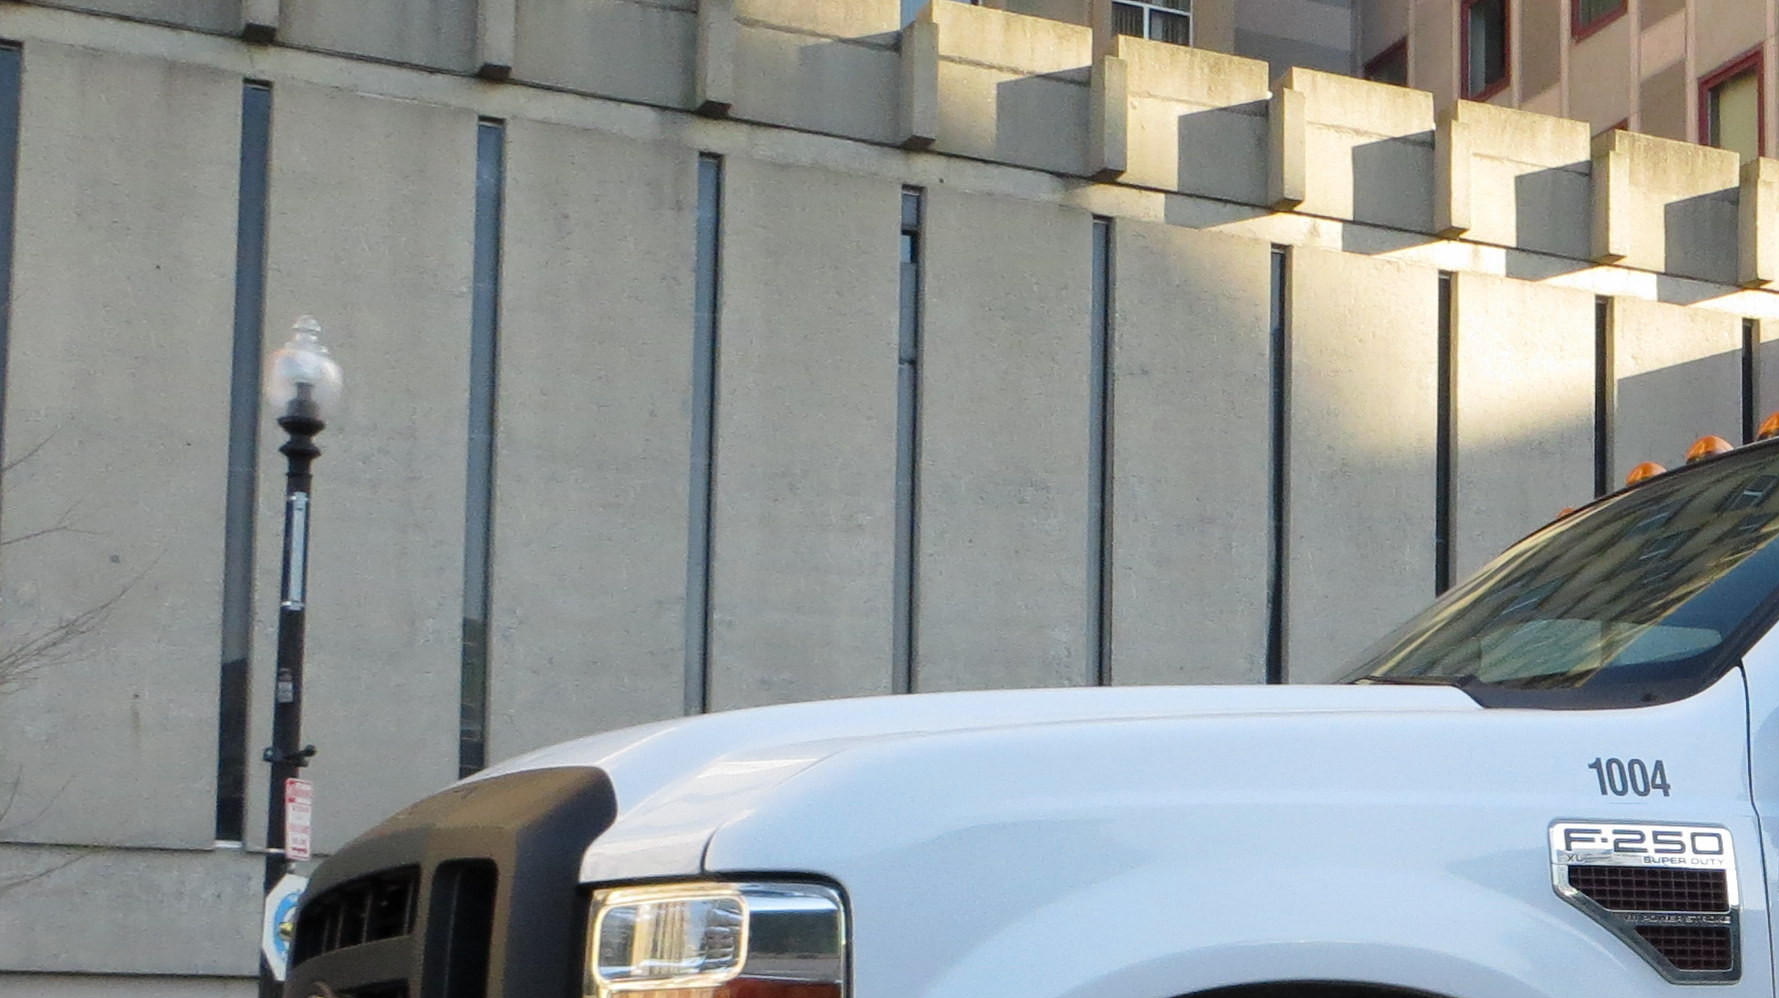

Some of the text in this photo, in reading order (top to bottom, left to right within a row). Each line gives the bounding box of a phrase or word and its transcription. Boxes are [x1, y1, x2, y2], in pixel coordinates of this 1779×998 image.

[1588, 757, 1671, 797] 1004
[1564, 828, 1724, 855] F-250
[1643, 856, 1687, 864] SUPER
